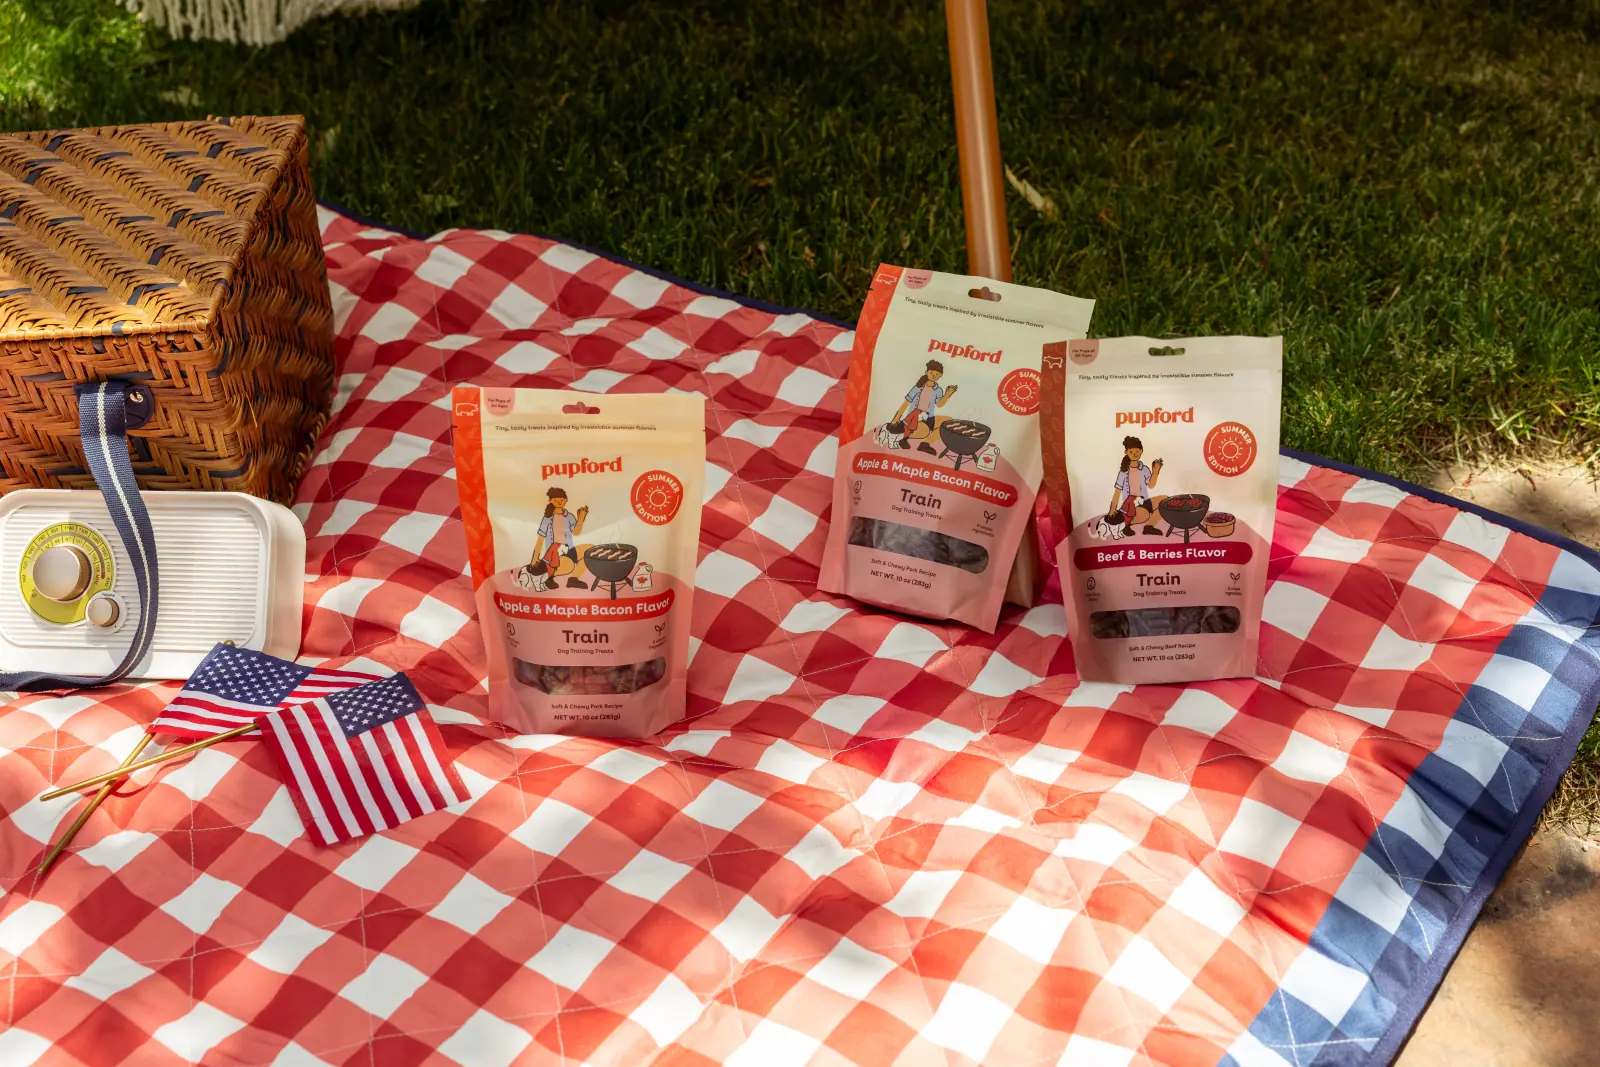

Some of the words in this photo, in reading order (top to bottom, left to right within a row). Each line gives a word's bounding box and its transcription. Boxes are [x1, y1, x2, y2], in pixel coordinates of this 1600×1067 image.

[918, 300, 932, 308] tasty
[949, 306, 970, 315] inspired
[977, 313, 1004, 321] irresistible
[928, 339, 1002, 364] pupford
[1019, 371, 1041, 387] SUMM
[1001, 393, 1027, 412] EDITION
[1115, 407, 1194, 428] pupford
[1221, 425, 1252, 444] SUMMER
[541, 457, 622, 481] pupford
[1208, 455, 1238, 473] EDITION
[647, 474, 680, 493] SUMMER
[857, 458, 880, 470] Apple
[881, 460, 889, 470] &
[891, 461, 930, 479] Maple
[932, 470, 970, 489] Bacon
[973, 481, 1011, 501] Flavor
[900, 488, 942, 509] Train
[636, 503, 667, 522] EDITION
[903, 507, 925, 517] Training
[925, 512, 942, 520] Treats
[1097, 550, 1124, 563] Beef
[1127, 550, 1136, 560] &
[1139, 549, 1183, 560] Berries
[1185, 548, 1227, 558] Flavor
[887, 562, 906, 571] Chewy
[919, 569, 937, 578] Recipe
[1136, 572, 1181, 587] Train
[911, 579, 932, 590] (283g)
[500, 598, 530, 614] Apple
[532, 604, 542, 615] &
[545, 604, 588, 618] Maple
[591, 604, 633, 616] Bacon
[635, 597, 670, 614] Flavor
[562, 629, 609, 644] Train
[599, 713, 621, 721] (283g)
